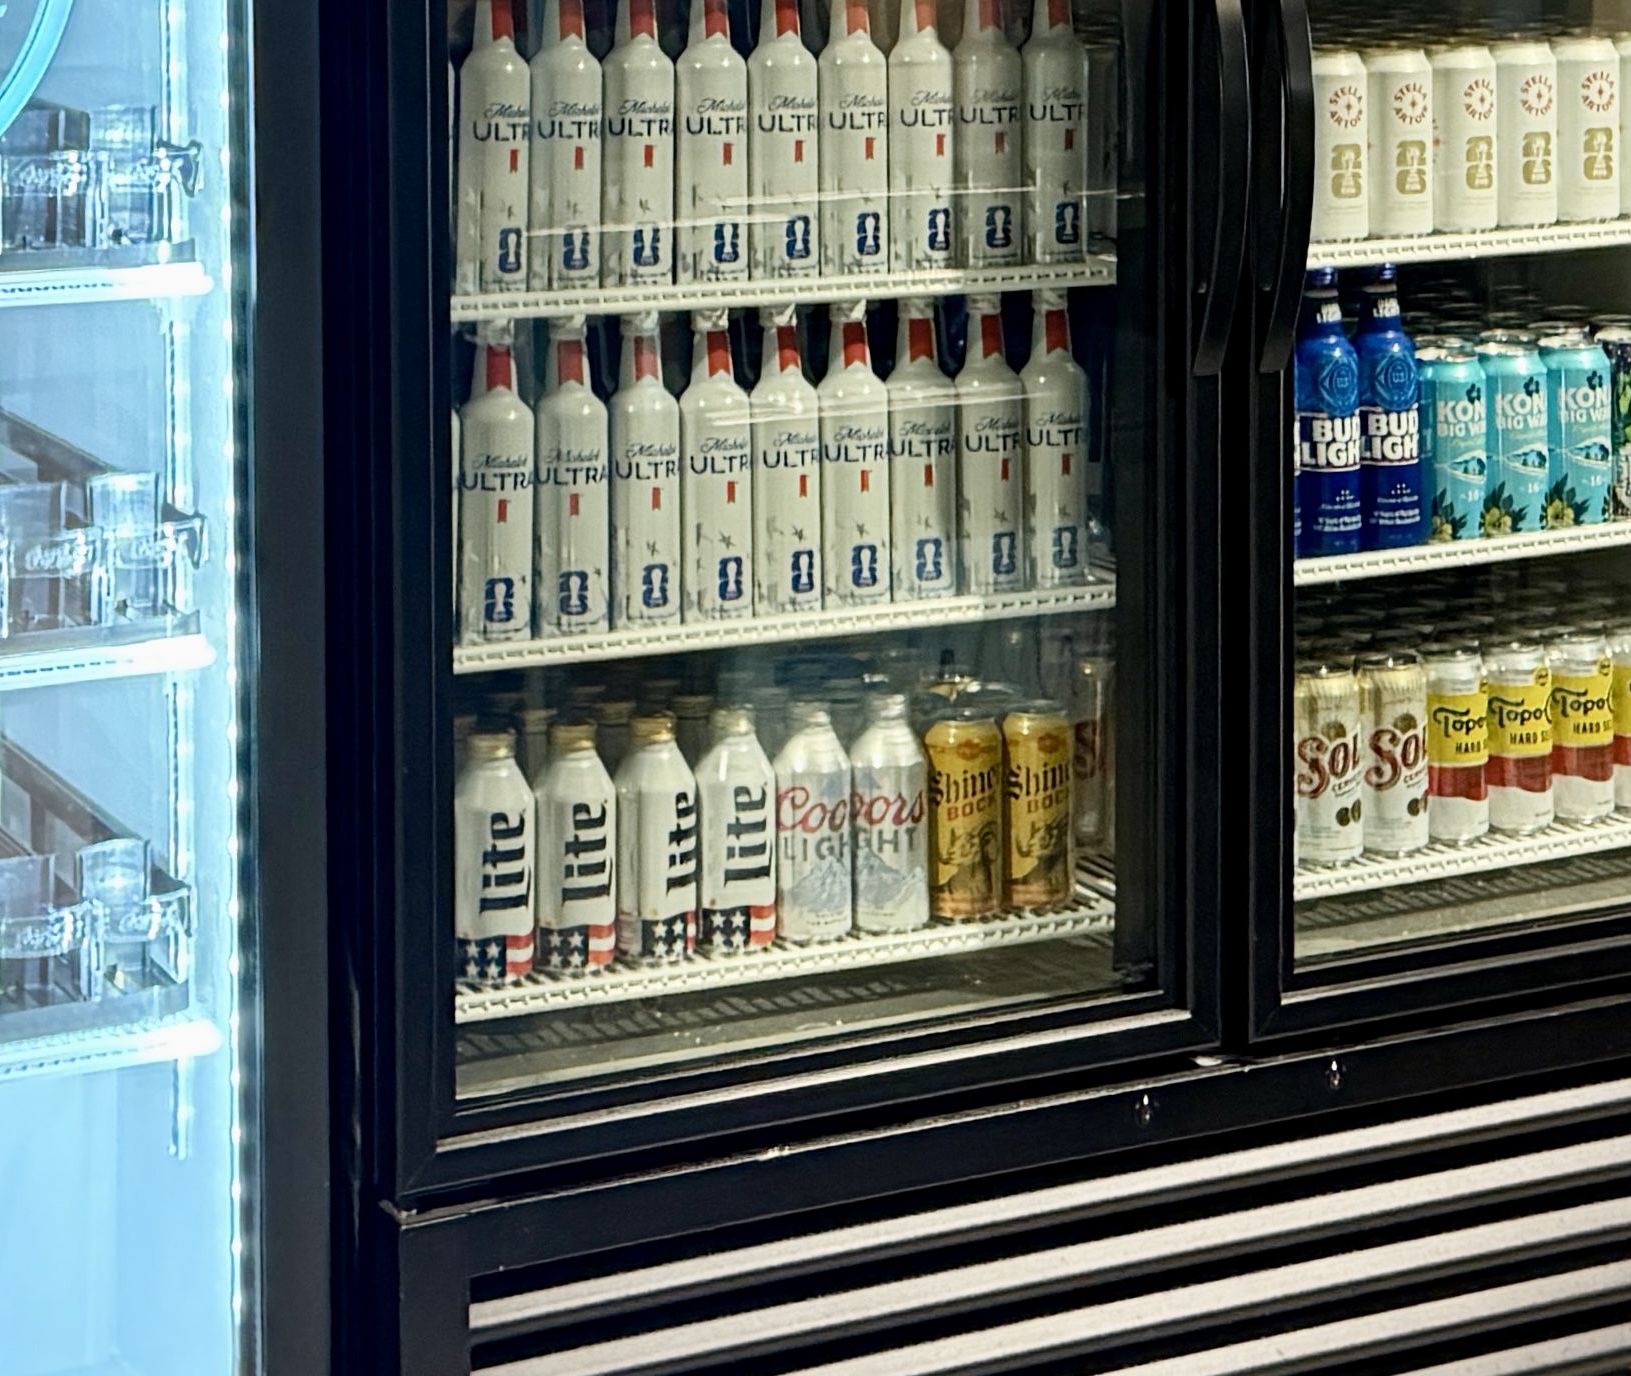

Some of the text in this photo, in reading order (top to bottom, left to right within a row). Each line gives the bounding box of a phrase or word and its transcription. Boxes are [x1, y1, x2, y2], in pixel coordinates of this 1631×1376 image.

[1581, 70, 1615, 89] STELLA
[1327, 84, 1363, 105] STELLA
[1392, 82, 1428, 102] STELLA
[608, 116, 673, 138] ULTR
[1494, 392, 1546, 416] KON
[1557, 385, 1610, 409] KON
[1436, 398, 1486, 423] KON
[1301, 439, 1361, 467] LIGH
[1361, 432, 1419, 460] LIGH
[1487, 695, 1543, 729] Topo
[1551, 686, 1606, 719] Topo
